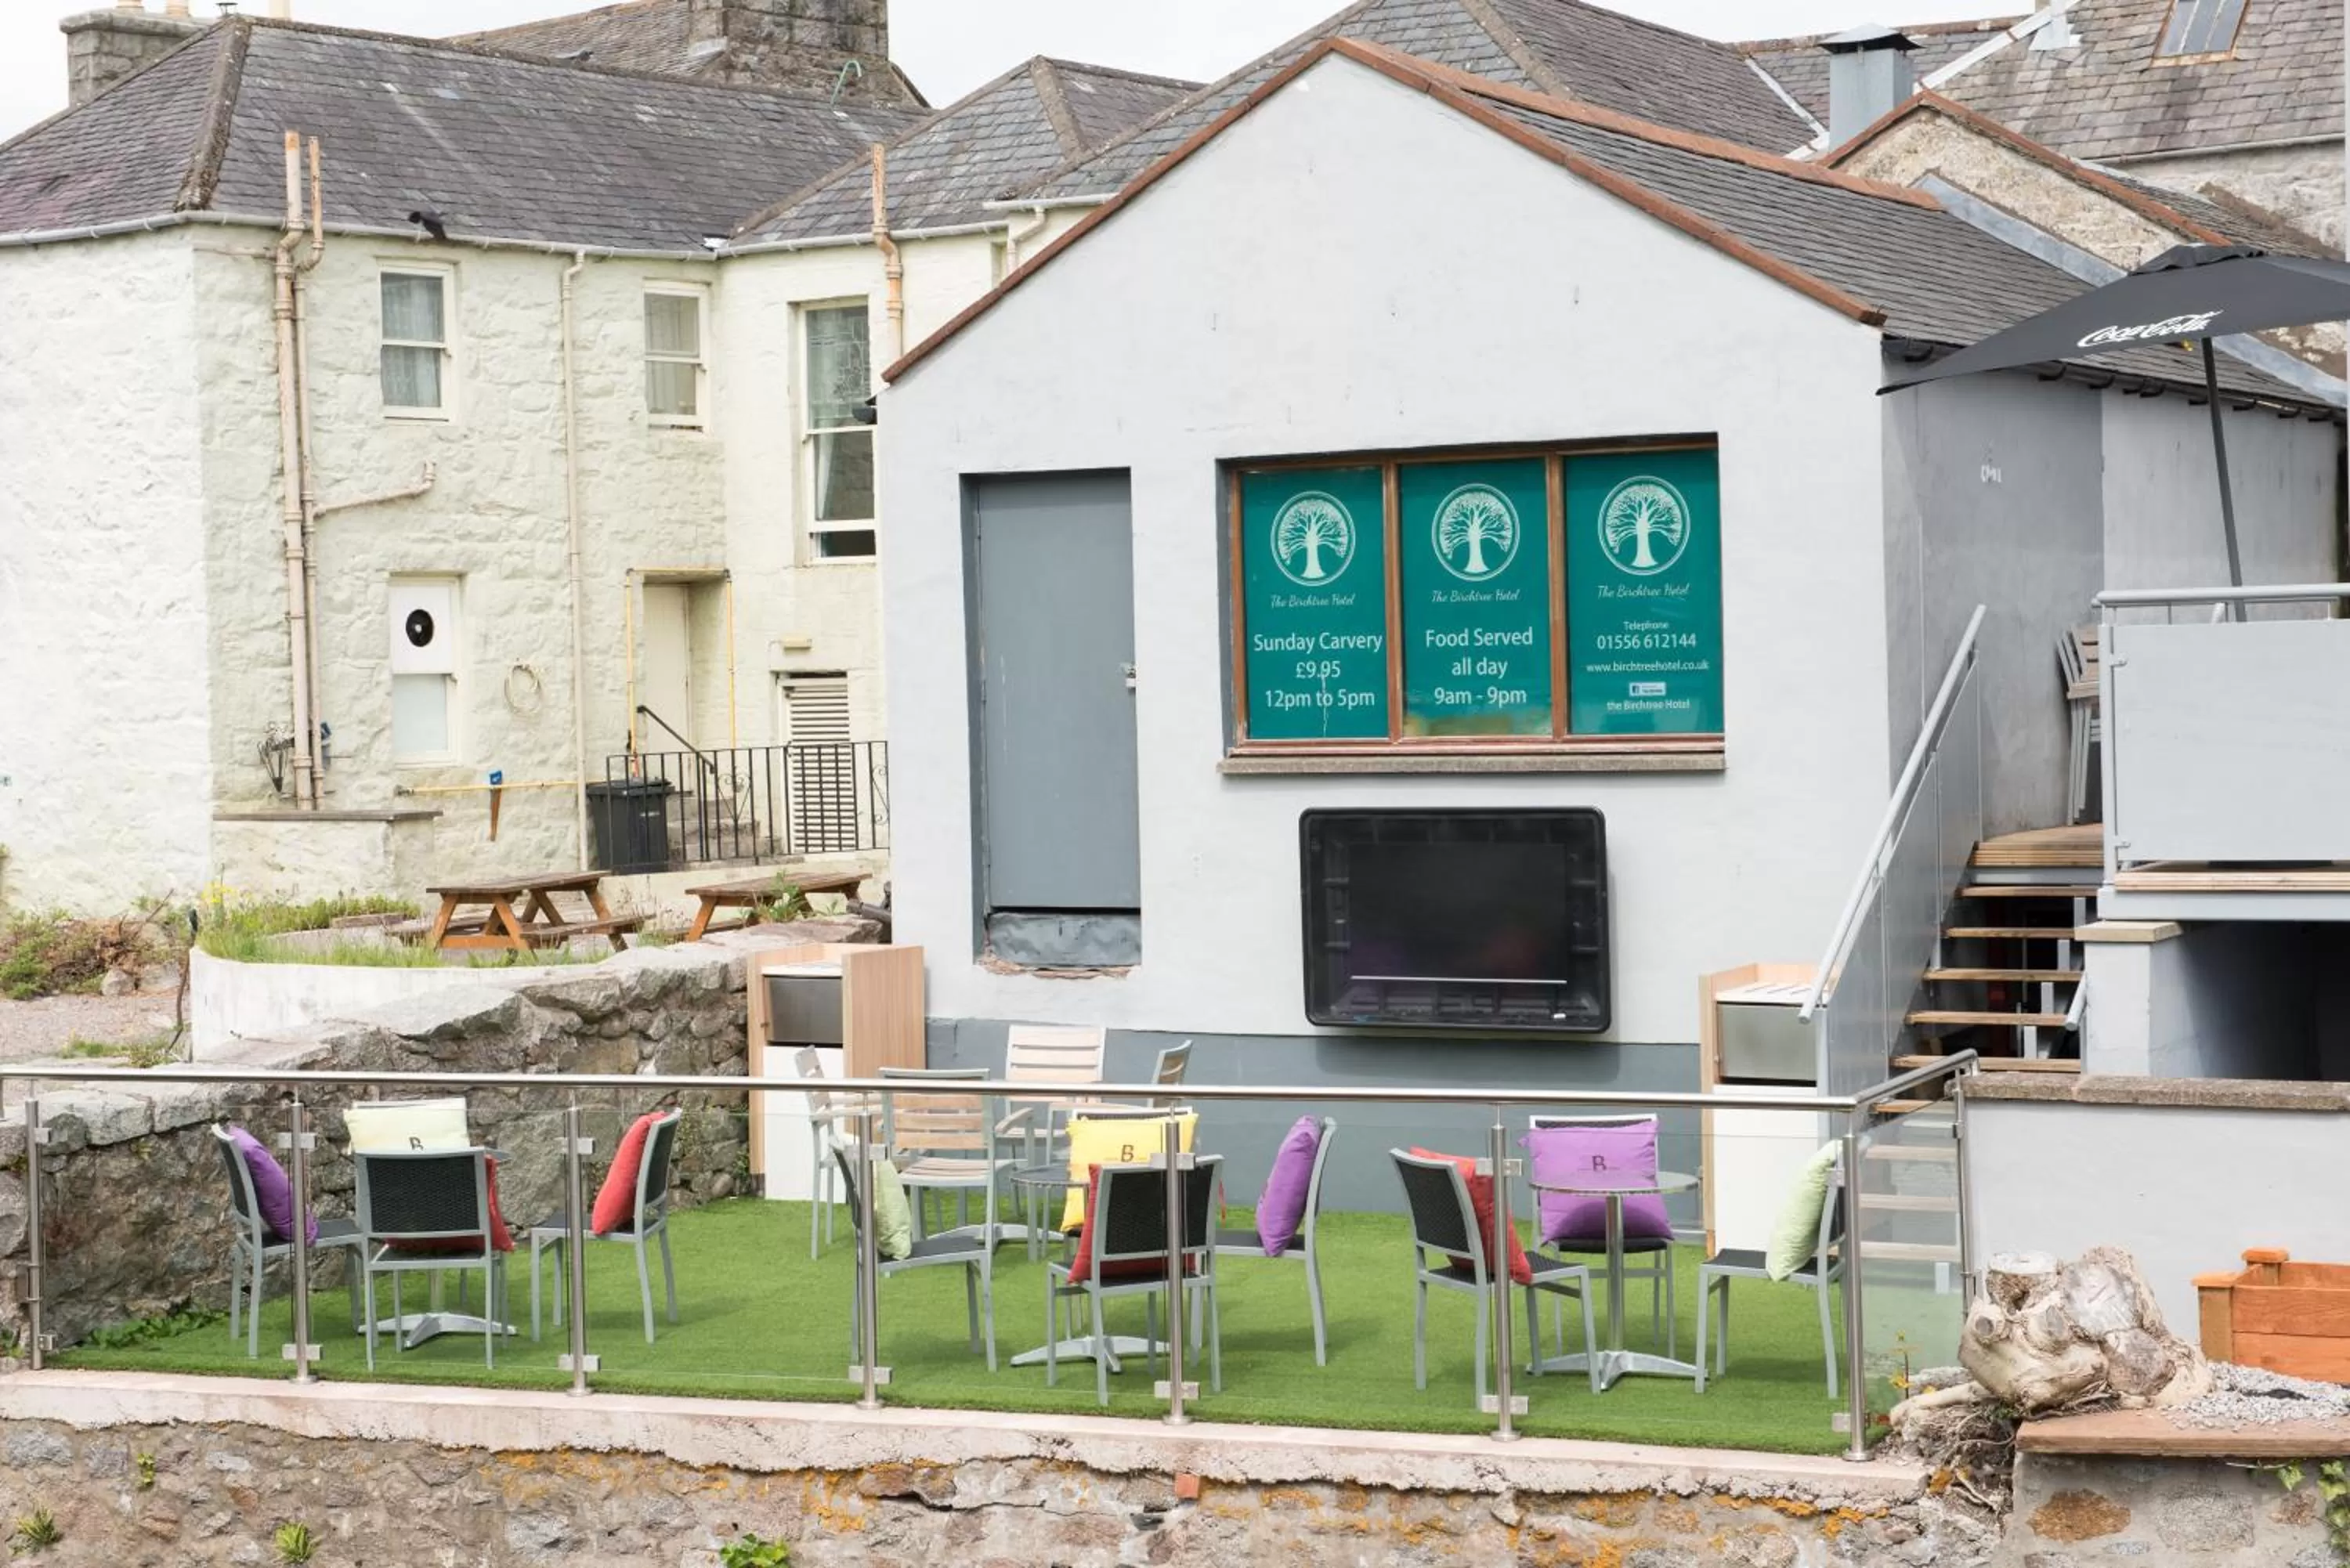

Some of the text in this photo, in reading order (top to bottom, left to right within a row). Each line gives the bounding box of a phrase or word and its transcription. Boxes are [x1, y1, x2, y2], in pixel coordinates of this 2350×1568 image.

[1432, 589, 1520, 602] The Birchtree Hotel
[1597, 583, 1690, 599] The Birchtree Hotel
[1270, 593, 1356, 608] The Birchtree Hotel
[1623, 620, 1669, 631] Telephone
[1253, 632, 1383, 654] Sunday Carvery
[1426, 627, 1533, 648] Food Served
[1596, 633, 1697, 649] 01556 612144
[1296, 660, 1340, 678] £9.95
[1452, 656, 1508, 679] all day
[1586, 659, 1709, 672] www.birchtreehotel.co.uk
[1265, 689, 1375, 711] 12pm to 5pm
[1434, 687, 1471, 705] 9am
[1488, 686, 1527, 708] 9pm
[1607, 698, 1690, 711] the Birchtree Hotel
[1121, 1144, 1134, 1162] B
